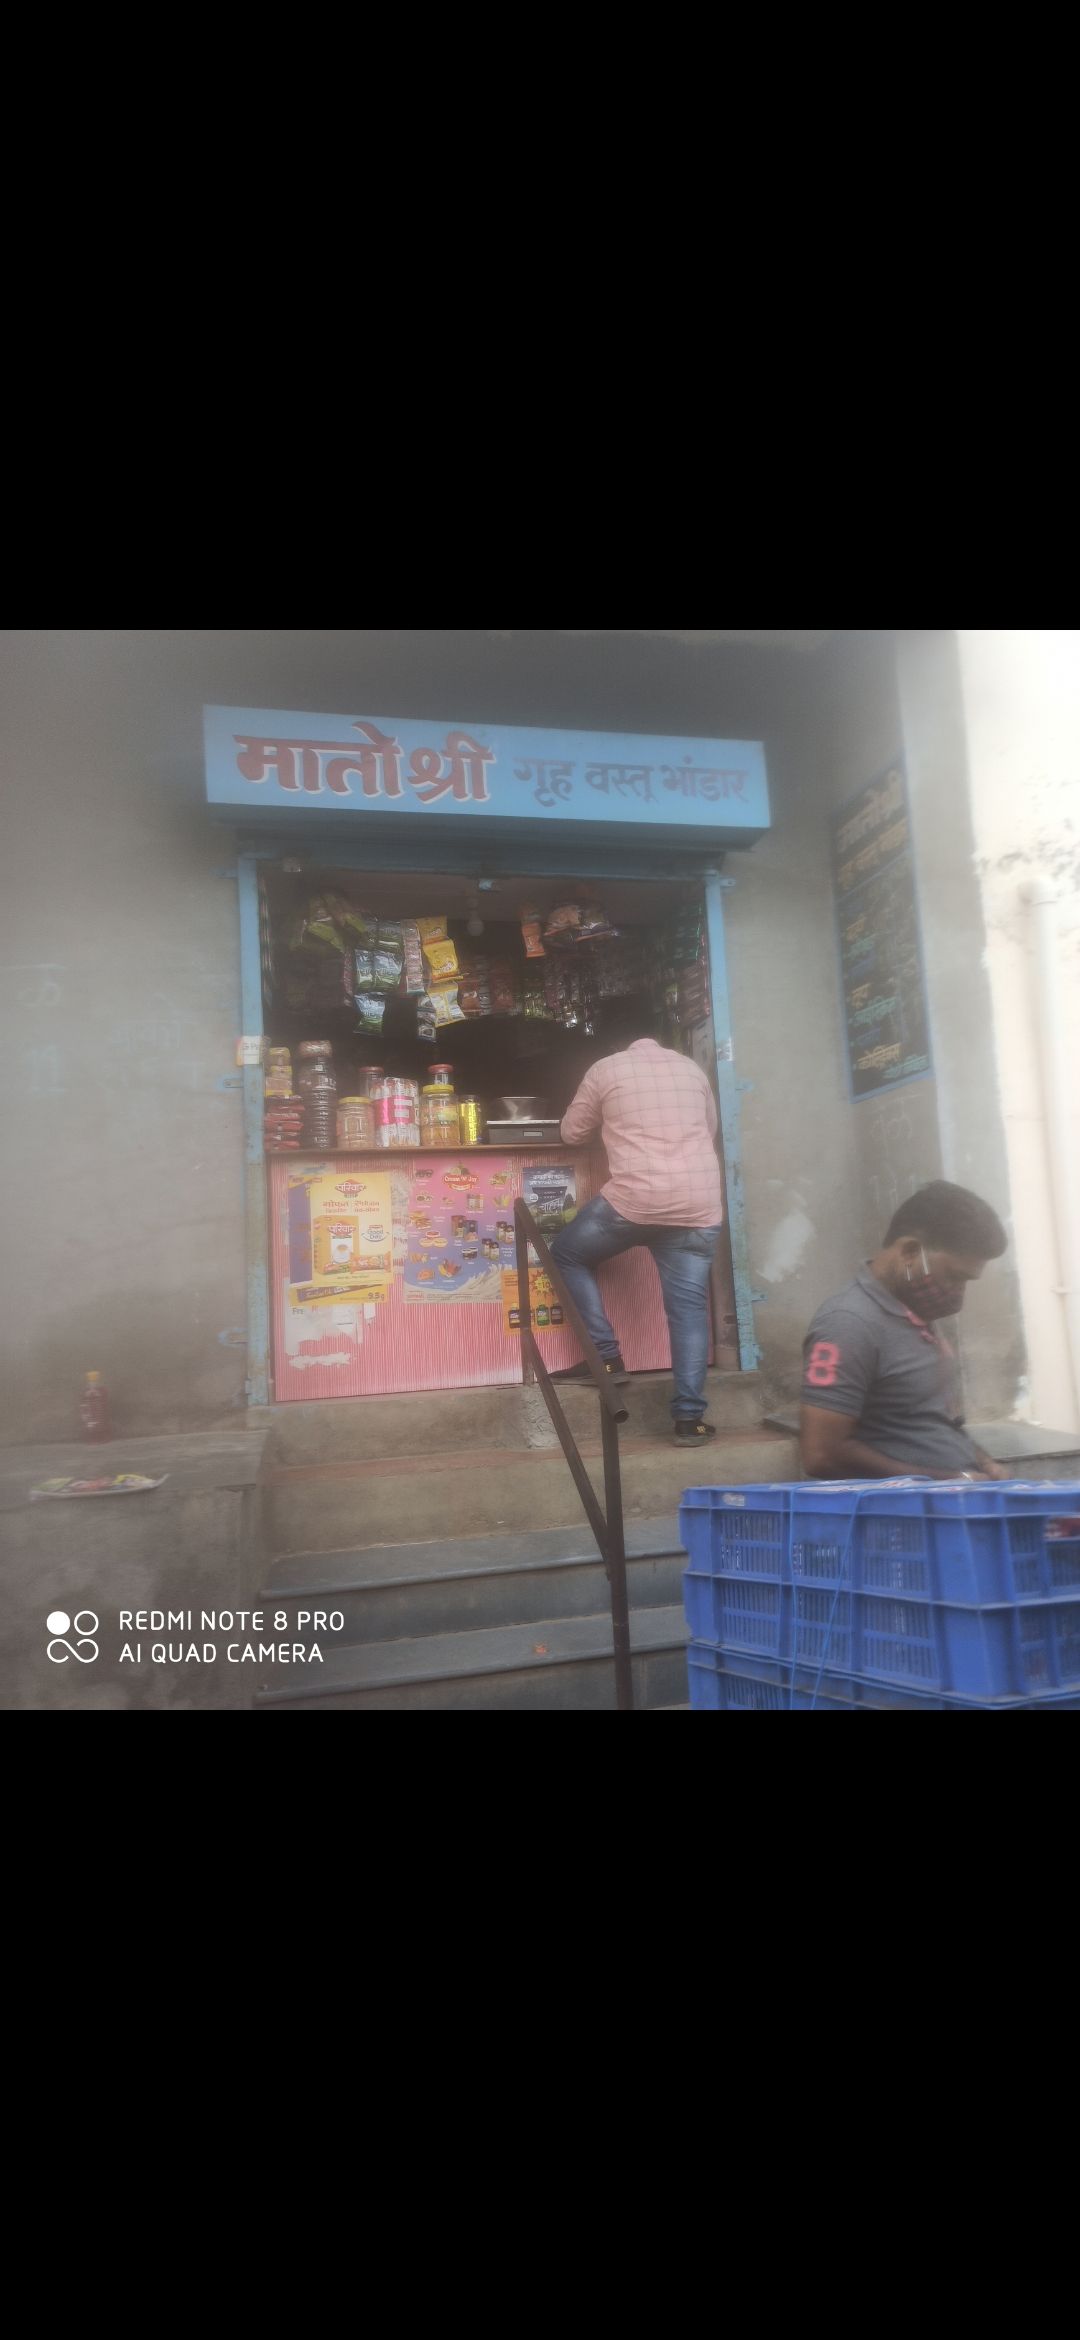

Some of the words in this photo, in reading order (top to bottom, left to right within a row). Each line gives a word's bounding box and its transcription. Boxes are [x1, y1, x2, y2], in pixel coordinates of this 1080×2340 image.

[233, 720, 497, 804] मातोश्री
[513, 756, 577, 808] गृह
[659, 755, 751, 804] भांडार
[806, 1341, 839, 1387] 8
